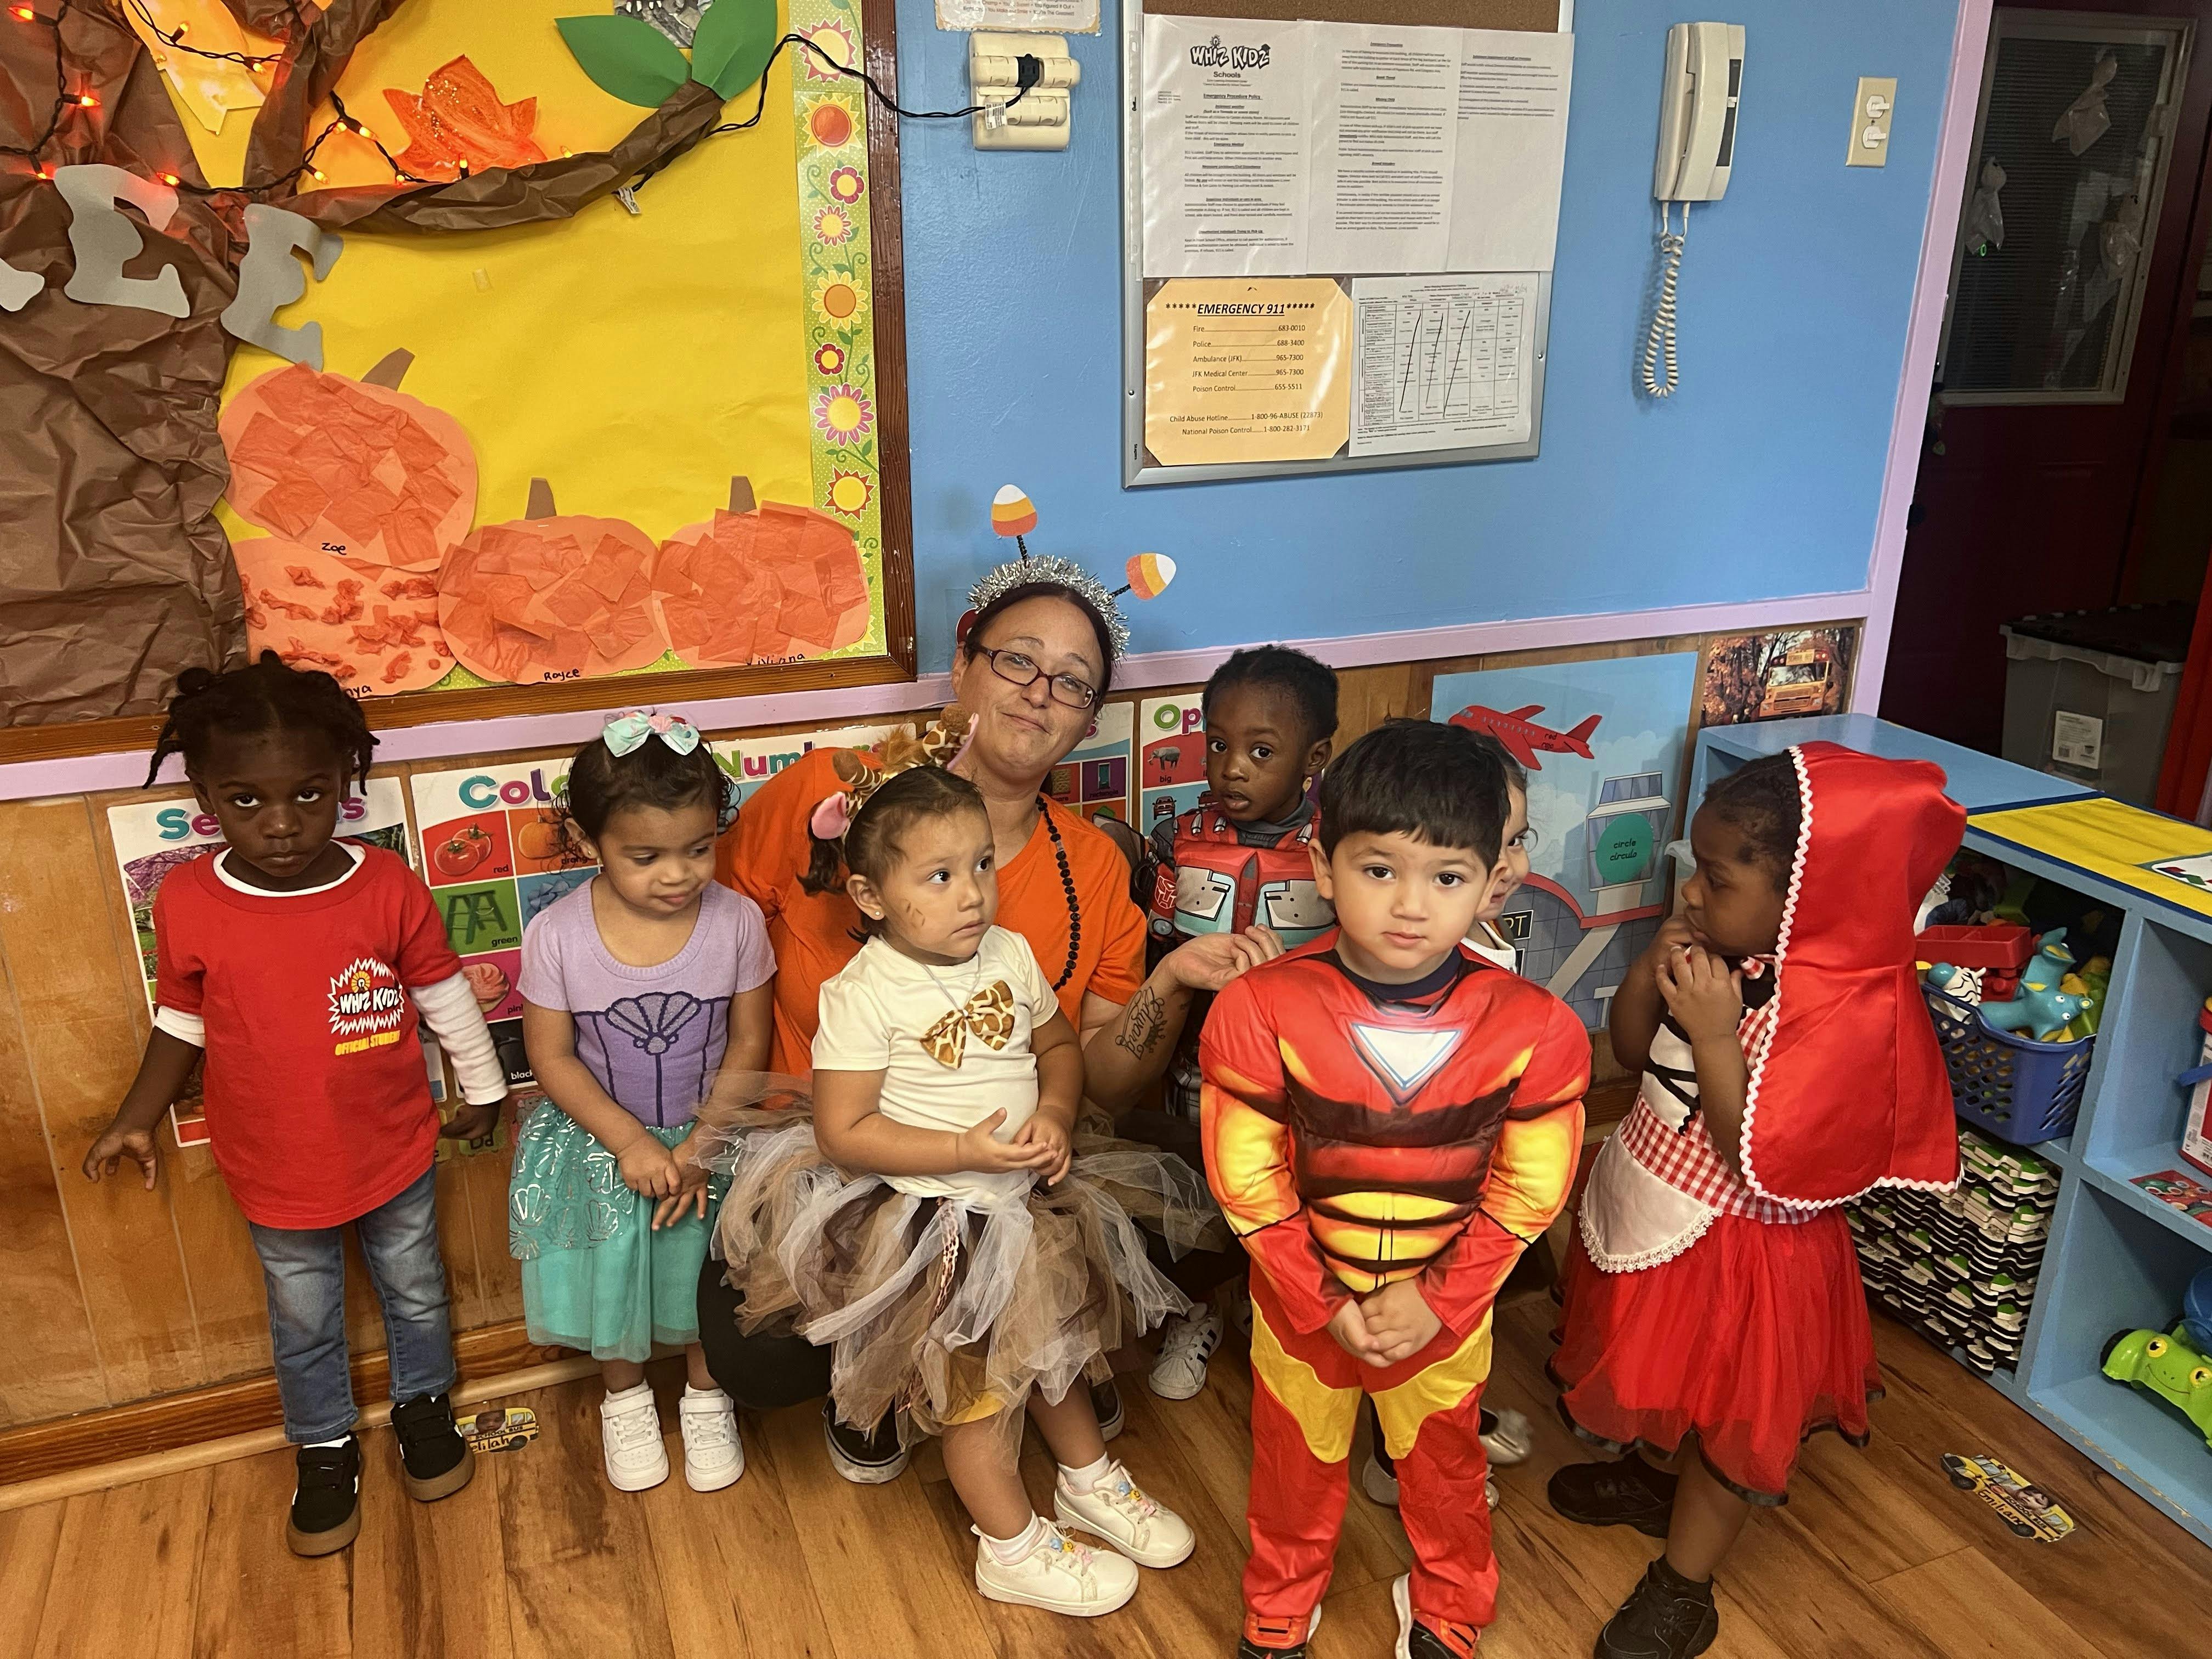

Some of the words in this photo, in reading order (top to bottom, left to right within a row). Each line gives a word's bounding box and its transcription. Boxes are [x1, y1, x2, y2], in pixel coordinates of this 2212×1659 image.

[1190, 46, 1229, 67] WHIZ
[1231, 46, 1271, 70] KIDZ
[1197, 303, 1264, 314] EMERGENCY
[1266, 304, 1285, 314] 911
[1300, 411, 1323, 420] (22873)
[321, 542, 347, 555] Zoe
[544, 669, 580, 681] Royce
[1159, 775, 1172, 783] big
[1613, 838, 1637, 849] circle
[561, 856, 589, 865] orang
[493, 864, 509, 873] red
[491, 935, 518, 947] green
[340, 991, 371, 1014] WHIZ
[373, 987, 400, 1012] KIDZ
[335, 1037, 370, 1056] OFFICIAL
[370, 1029, 400, 1048] STUDENT
[471, 1435, 510, 1452] elilah
